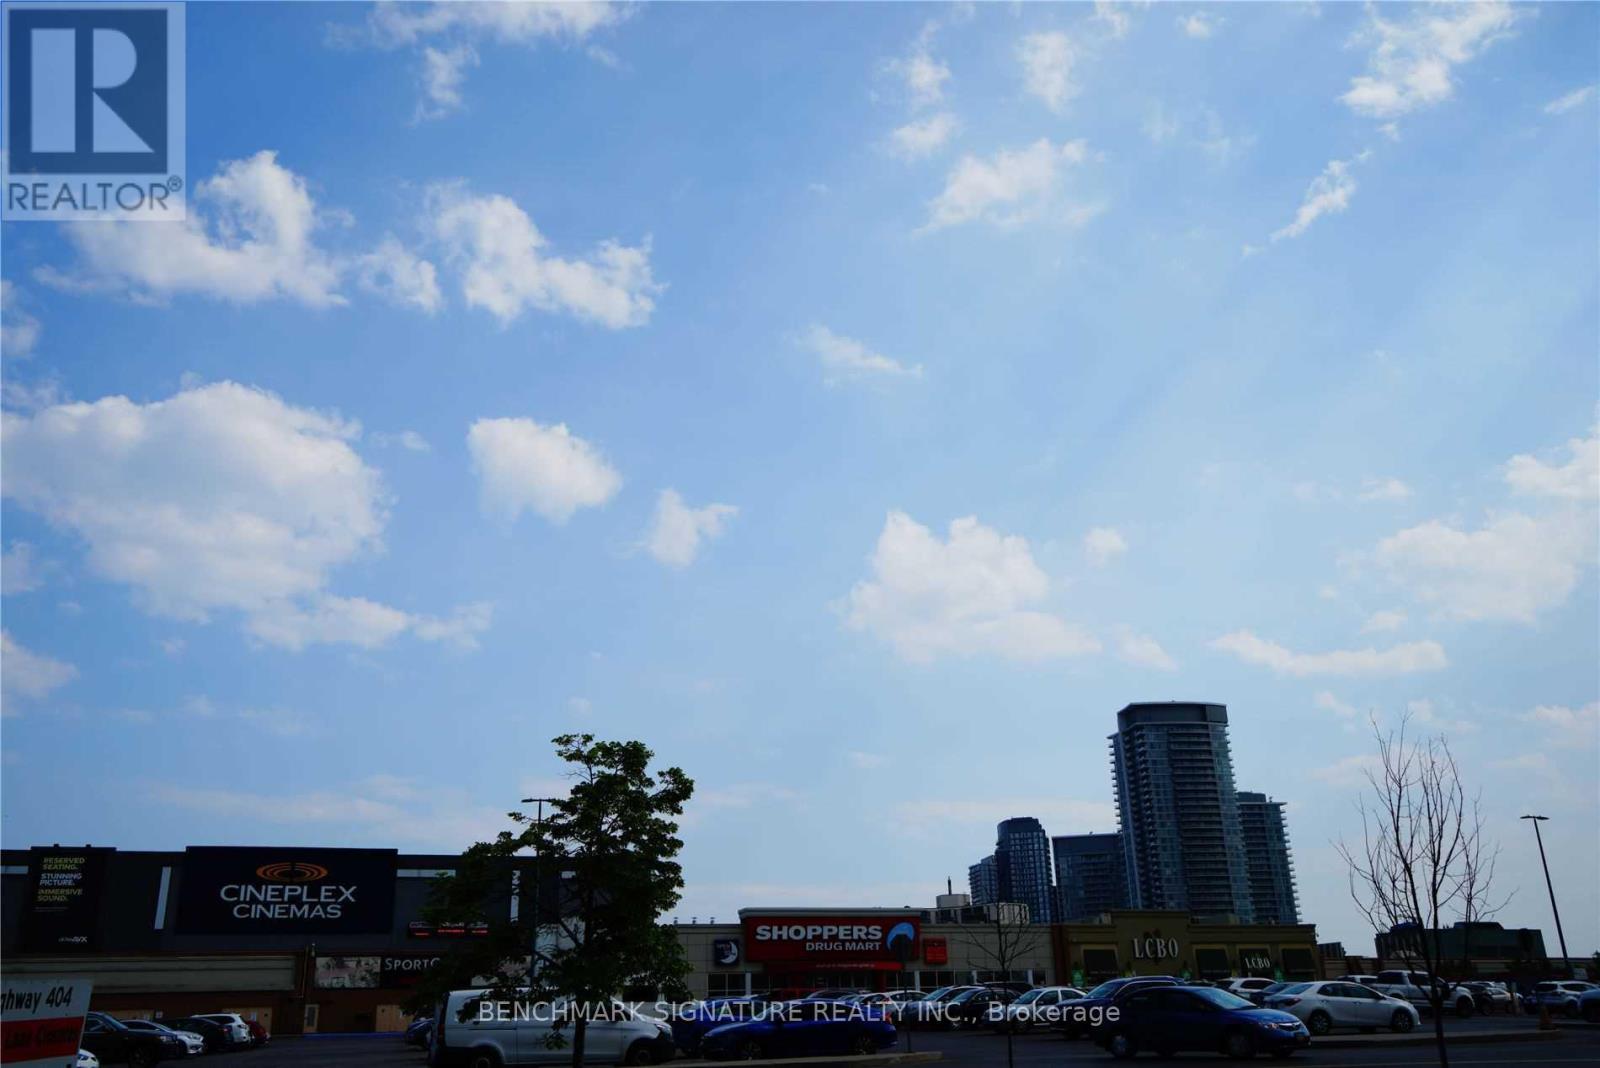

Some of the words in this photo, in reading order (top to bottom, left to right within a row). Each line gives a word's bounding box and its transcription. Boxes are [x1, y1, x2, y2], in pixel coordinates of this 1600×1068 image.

[219, 884, 358, 903] CINEPLEX
[232, 903, 343, 919] CINEMAS
[755, 925, 882, 941] SHOPPERS
[806, 942, 843, 951] DRUG
[845, 941, 882, 951] MART
[1132, 937, 1179, 960] LCBO
[1244, 956, 1272, 969] LCBO
[45, 985, 74, 1008] 404
